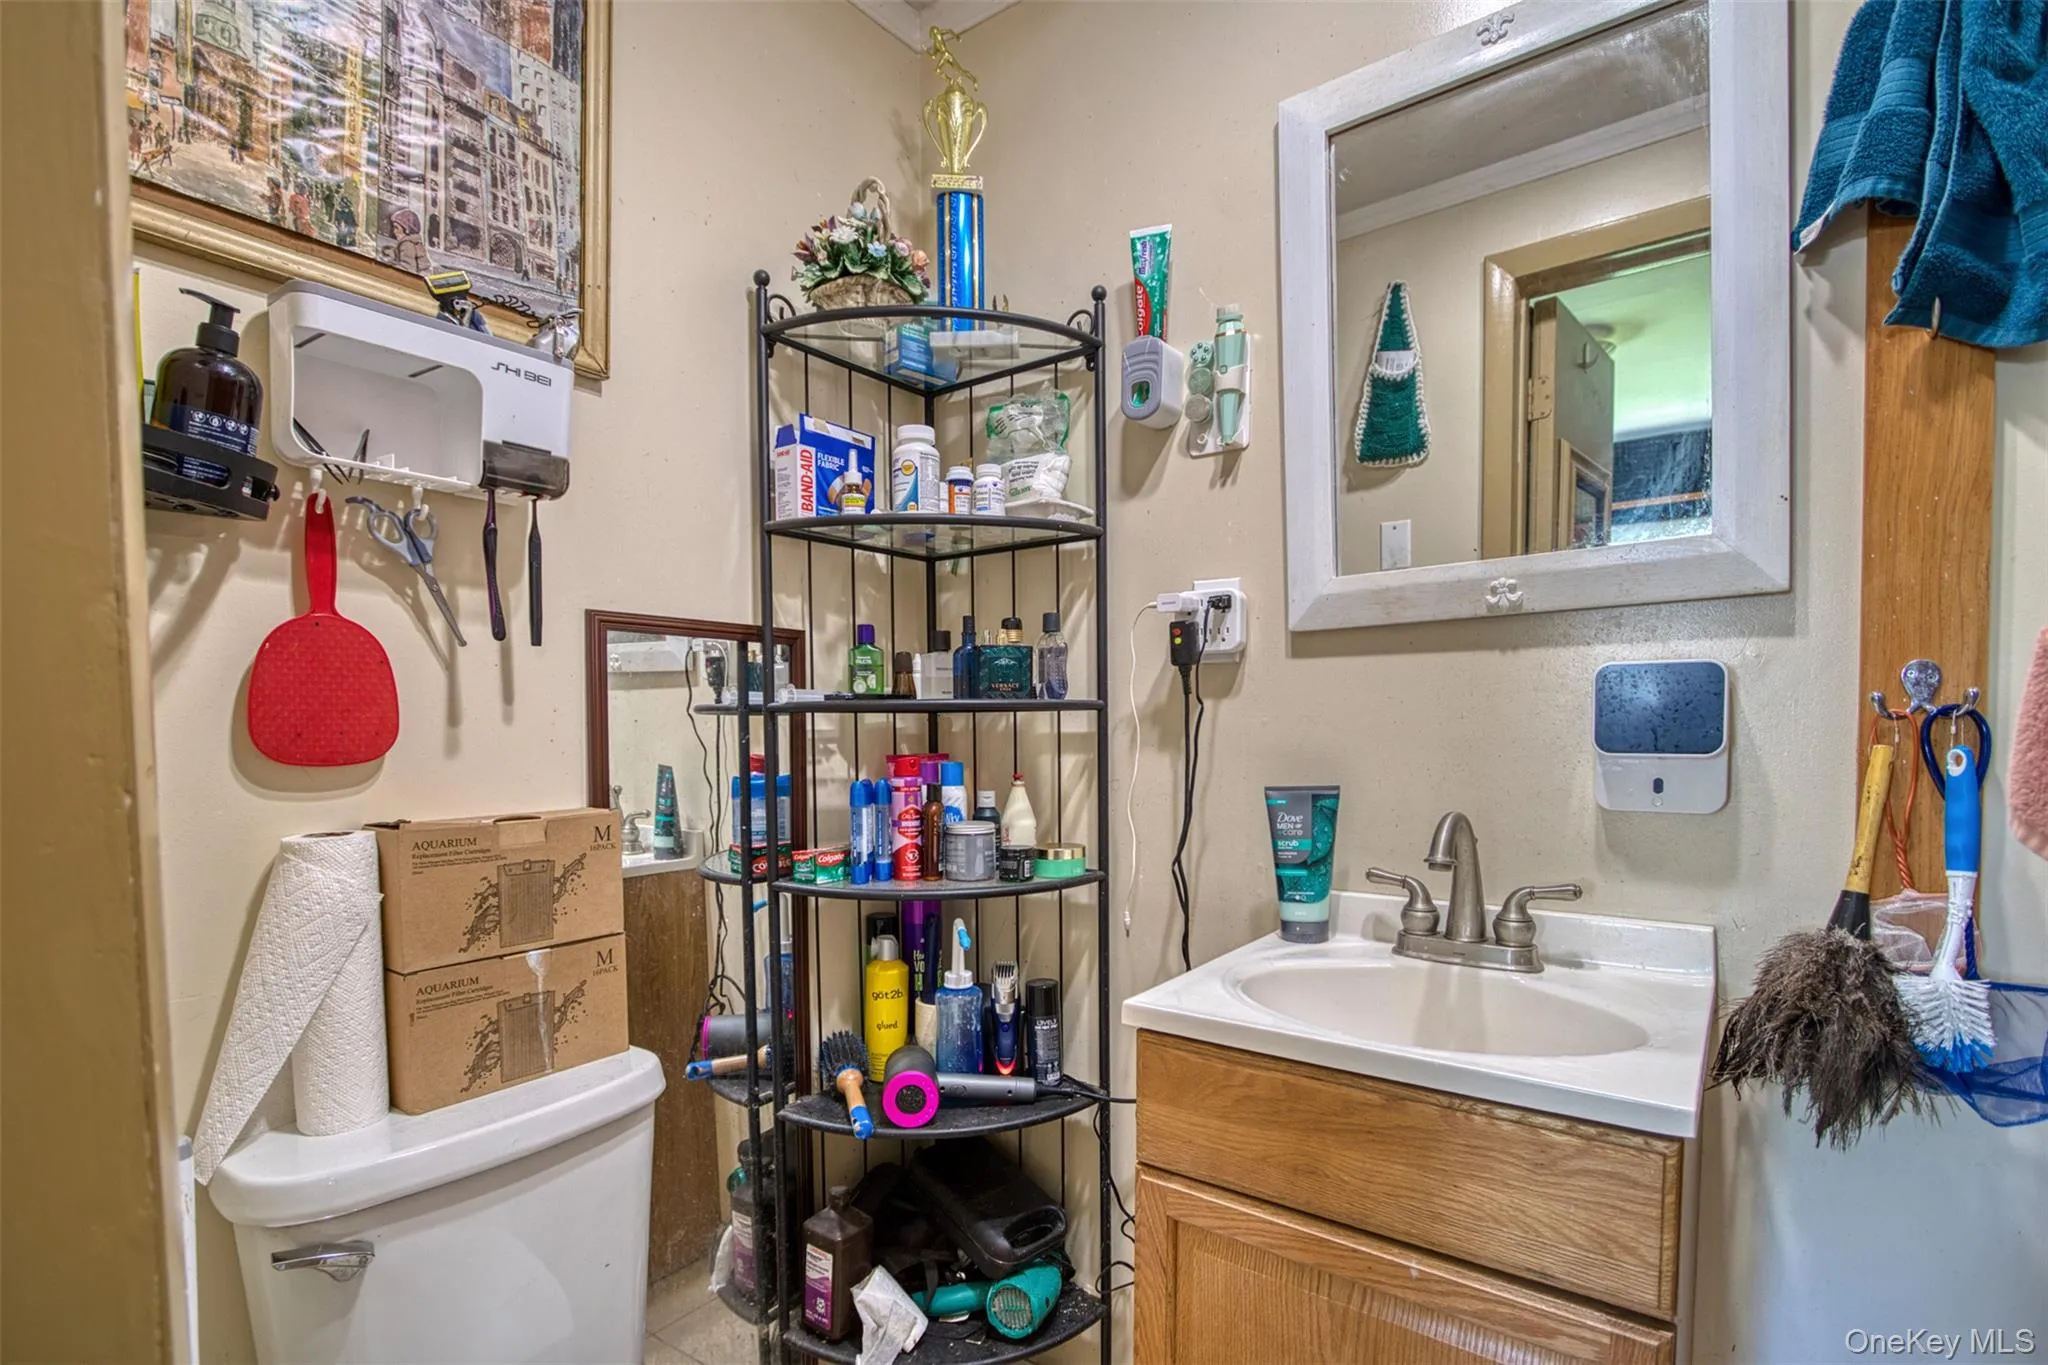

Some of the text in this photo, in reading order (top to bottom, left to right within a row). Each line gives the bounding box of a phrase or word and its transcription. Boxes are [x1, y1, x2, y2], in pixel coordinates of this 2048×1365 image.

[490, 361, 552, 387] SHI BEI
[816, 451, 845, 467] FLEXIBLE
[816, 459, 840, 472] FABRIC
[800, 448, 814, 513] BAND-AID
[1277, 811, 1304, 823] Dove
[594, 824, 612, 843] M
[411, 837, 478, 852] AQUARIUM
[1277, 839, 1300, 847] scrub
[817, 853, 845, 864] Colgate
[596, 947, 614, 967] M
[415, 976, 479, 997] AQUARIUM
